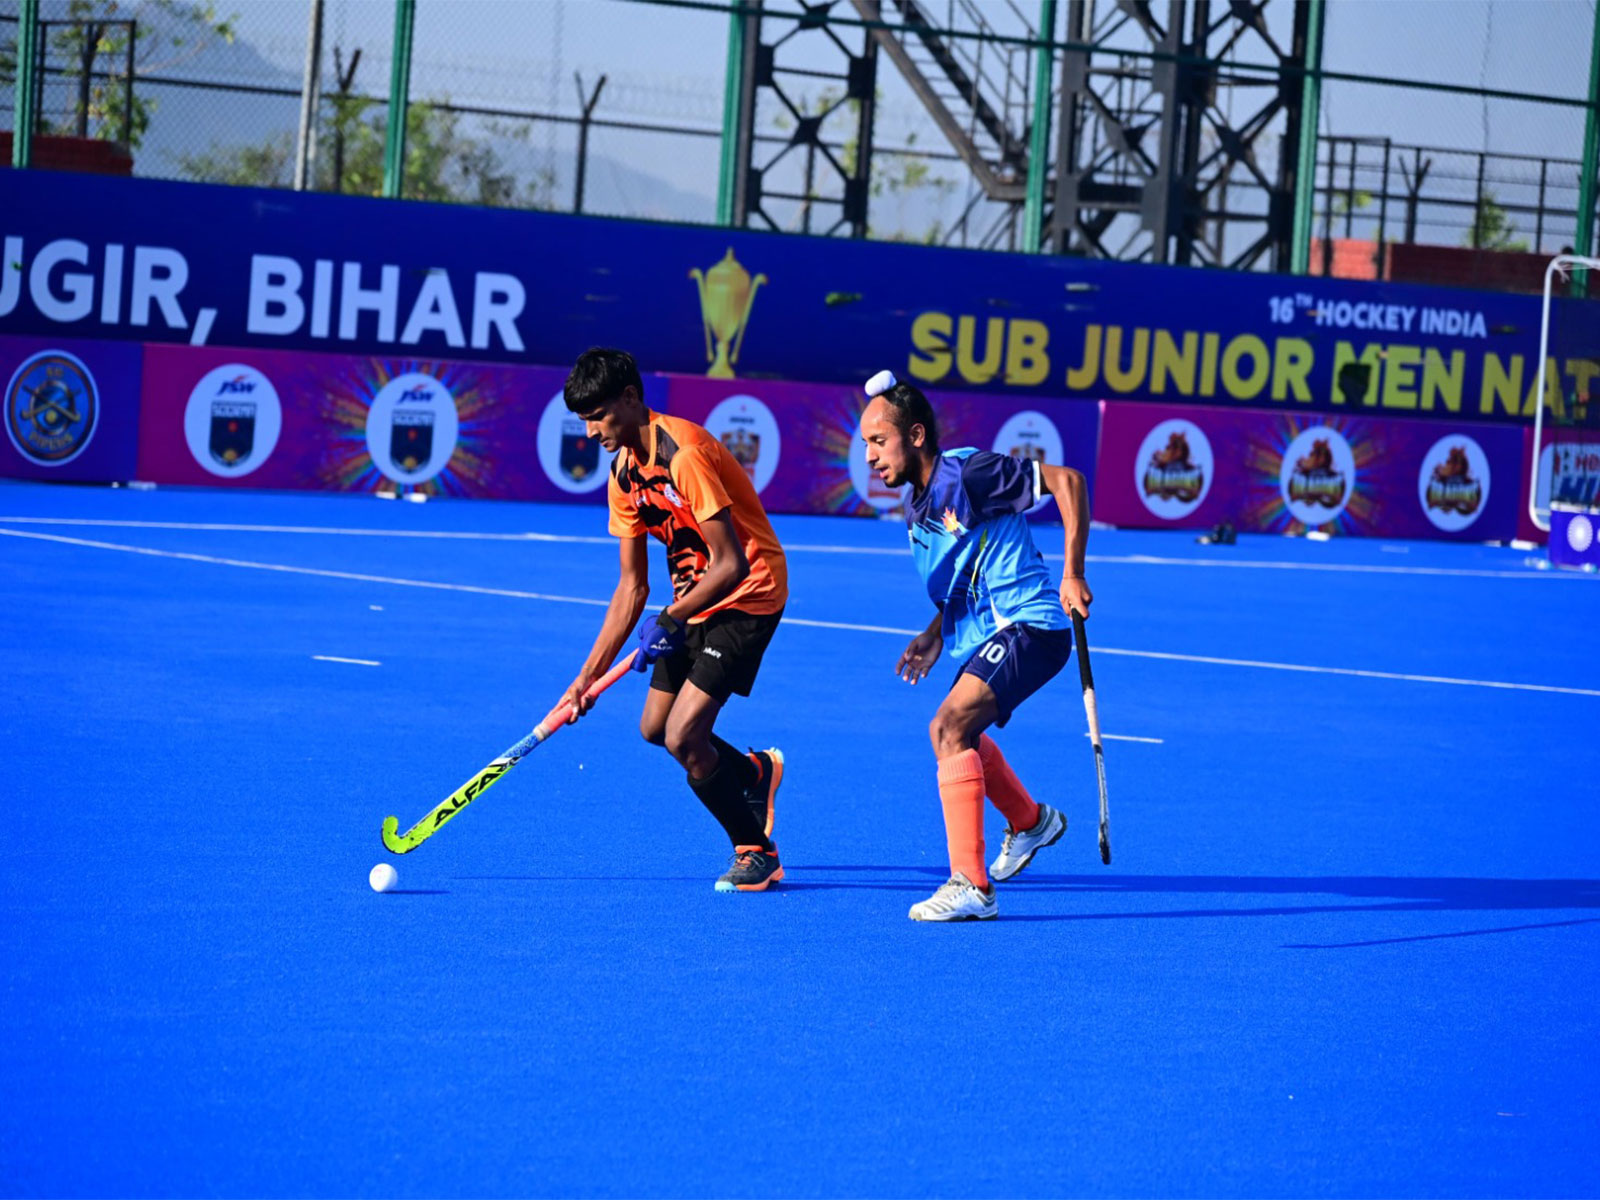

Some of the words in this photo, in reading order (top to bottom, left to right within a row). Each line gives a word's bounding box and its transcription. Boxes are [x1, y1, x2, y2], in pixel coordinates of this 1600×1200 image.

[247, 254, 526, 352] BIHAR
[1315, 300, 1416, 332] HOCKEY
[1420, 307, 1487, 338] INDIA
[908, 312, 1050, 386] SUB
[1067, 324, 1314, 402] JUNIOR
[1331, 341, 1465, 412] MEN
[978, 641, 1006, 663] 10
[434, 773, 501, 828] ALFA
